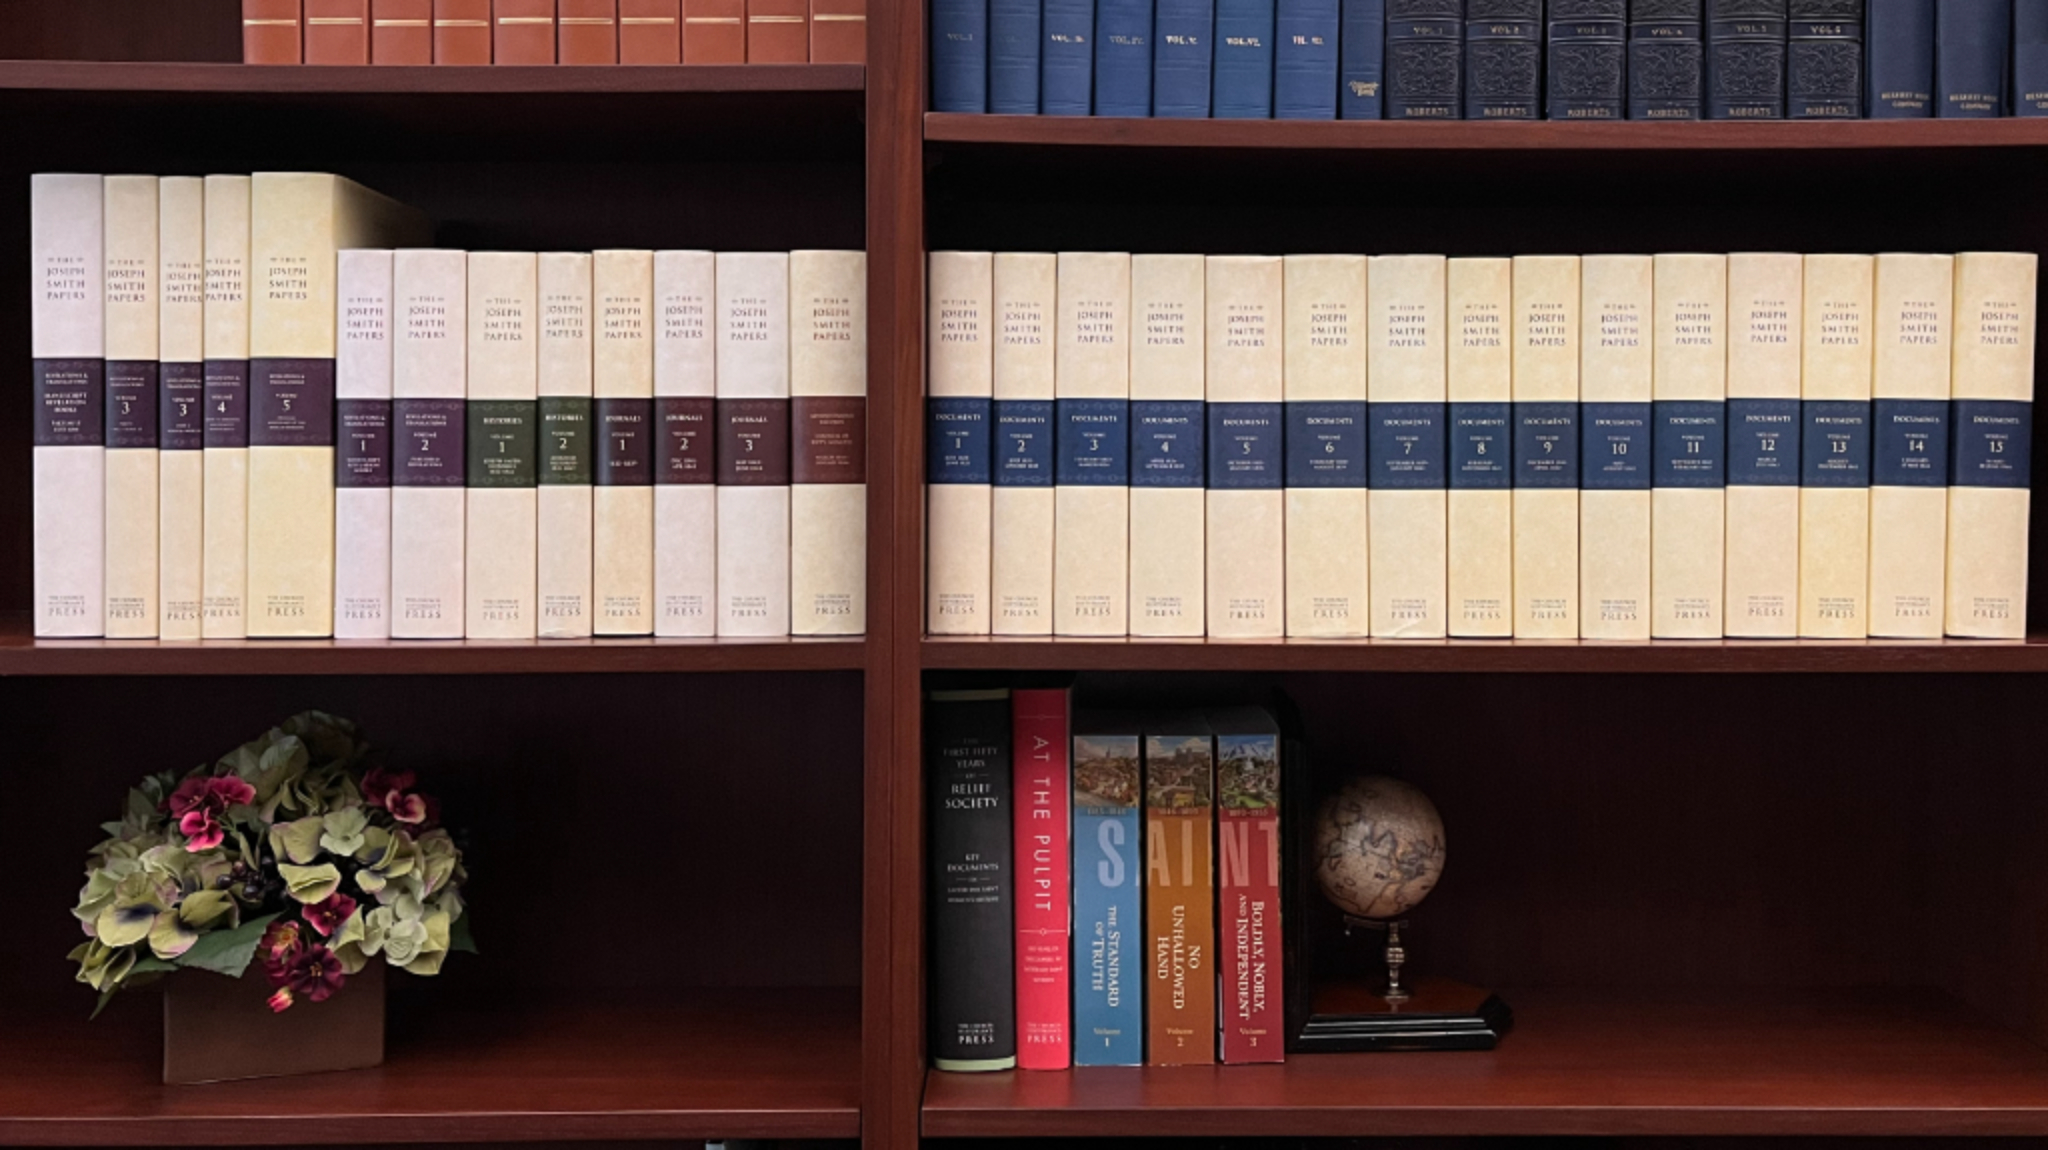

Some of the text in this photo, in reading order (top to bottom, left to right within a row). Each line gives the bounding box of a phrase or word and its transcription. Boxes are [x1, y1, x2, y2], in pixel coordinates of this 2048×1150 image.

[47, 280, 85, 288] SMITH
[108, 282, 145, 290] SMITH
[269, 280, 306, 288] SMITH
[409, 319, 444, 327] SMITH
[731, 321, 766, 329] SMITH
[941, 322, 977, 331] SMITH
[1004, 324, 1040, 333] SMITH
[1078, 323, 1112, 332] SMITH
[1751, 323, 1787, 332] SMITH
[1901, 324, 1937, 332] SMITH
[1981, 324, 2019, 333] SMITH
[1148, 325, 1183, 334] SMITH
[1228, 327, 1264, 336] SMITH
[1312, 326, 1347, 334] SMITH
[1389, 327, 1425, 336] SMITH
[1463, 326, 1499, 335] SMITH
[1529, 326, 1565, 335] SMITH
[1601, 326, 1638, 335] SMITH
[1676, 325, 1711, 334] SMITH
[1822, 325, 1858, 334] SMITH
[121, 402, 131, 414] 3
[179, 404, 188, 416] 3
[217, 401, 226, 413] 4
[283, 400, 291, 412] 5
[360, 440, 366, 452] 1
[421, 439, 429, 451] 2
[499, 441, 505, 453] 1
[559, 438, 568, 450] 2
[619, 439, 625, 451] 1
[680, 438, 689, 450] 2
[745, 440, 753, 452] 3
[955, 437, 961, 449] 1
[1017, 440, 1026, 452] 2
[1089, 439, 1099, 451] 3
[1161, 441, 1169, 453] 4
[1242, 442, 1251, 454] 5
[1325, 441, 1335, 453] 6
[1403, 442, 1412, 454] 7
[1477, 442, 1486, 454] 8
[1543, 441, 1553, 453] 9
[1611, 443, 1627, 455] 10
[1686, 442, 1699, 454] 11
[1760, 439, 1775, 451] 12
[1831, 441, 1847, 453] 13
[1908, 440, 1924, 452] 14
[1988, 441, 2004, 453] 15
[951, 783, 992, 794] RELIEF
[945, 797, 998, 809] SOCIETY
[1033, 735, 1050, 911] AT THE PULPIT
[1251, 901, 1265, 959] BOLDLY,
[1107, 906, 1120, 1008] THE STANDARD
[1157, 936, 1170, 980] HAND
[1172, 905, 1185, 1009] UNHALLOWED
[1188, 945, 1200, 969] NO
[1236, 894, 1249, 1020] AND INDEPENDENT
[1092, 938, 1105, 991] TRUTH
